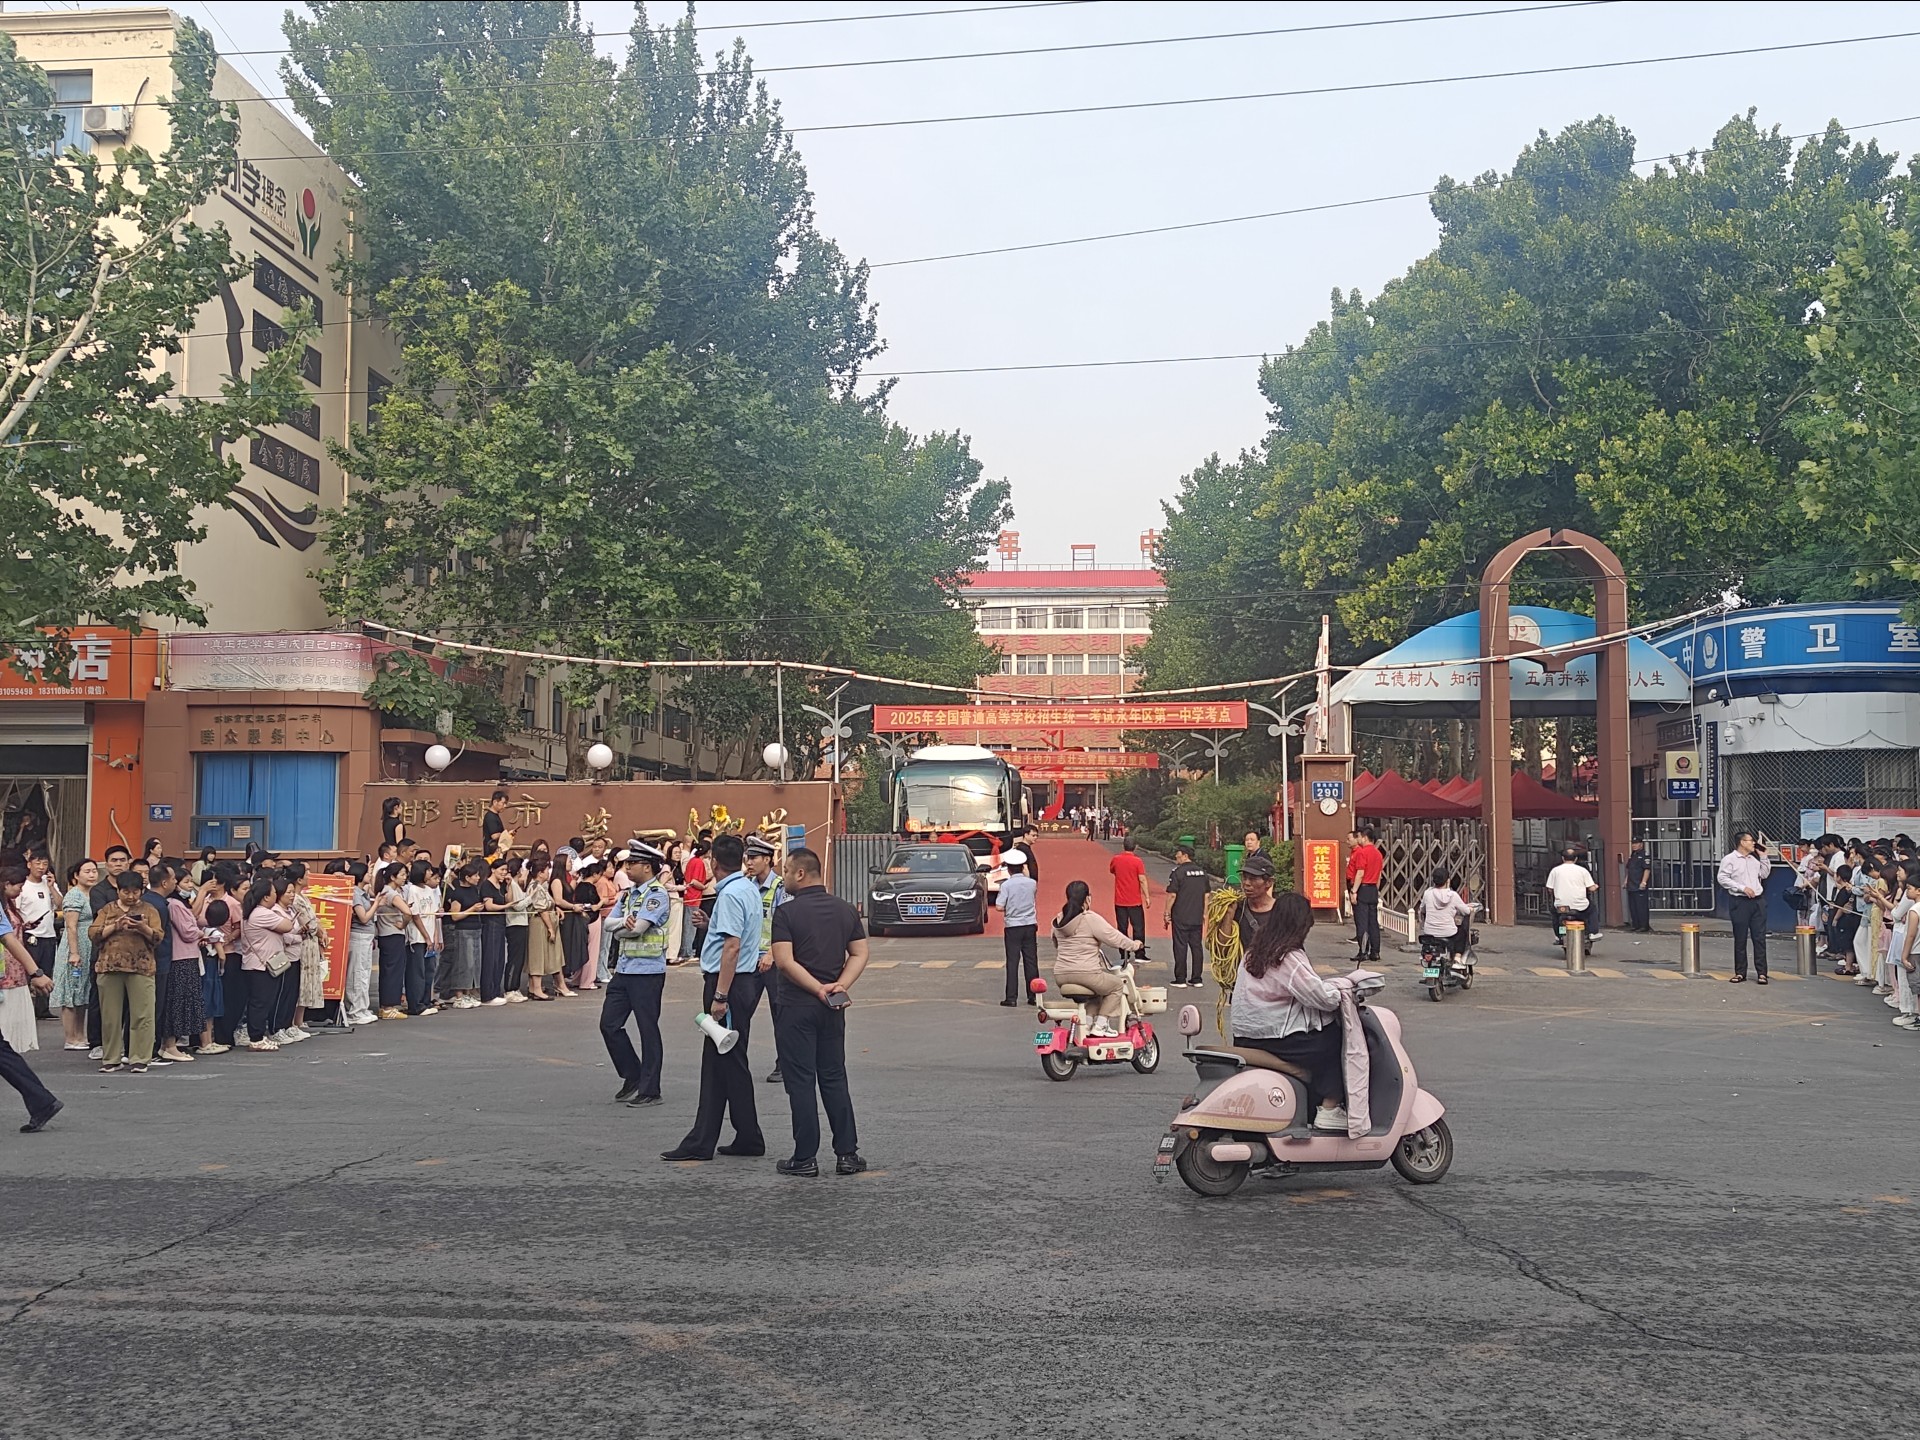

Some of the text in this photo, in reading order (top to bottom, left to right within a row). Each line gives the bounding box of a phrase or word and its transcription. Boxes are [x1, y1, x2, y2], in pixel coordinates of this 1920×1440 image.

[1741, 622, 1920, 660] 警卫室
[1375, 671, 1440, 687] 立德树人
[1525, 670, 1590, 687] 五育并举
[1628, 670, 1665, 687] 人生
[890, 705, 1232, 726] 2025年全国普通高等学校招生统一考试永年区第一中学考点
[200, 728, 335, 745] 群众服务中心
[1317, 788, 1339, 797] 290
[1034, 822, 1070, 832] 行合一
[1312, 845, 1331, 899] 禁止停放车辆
